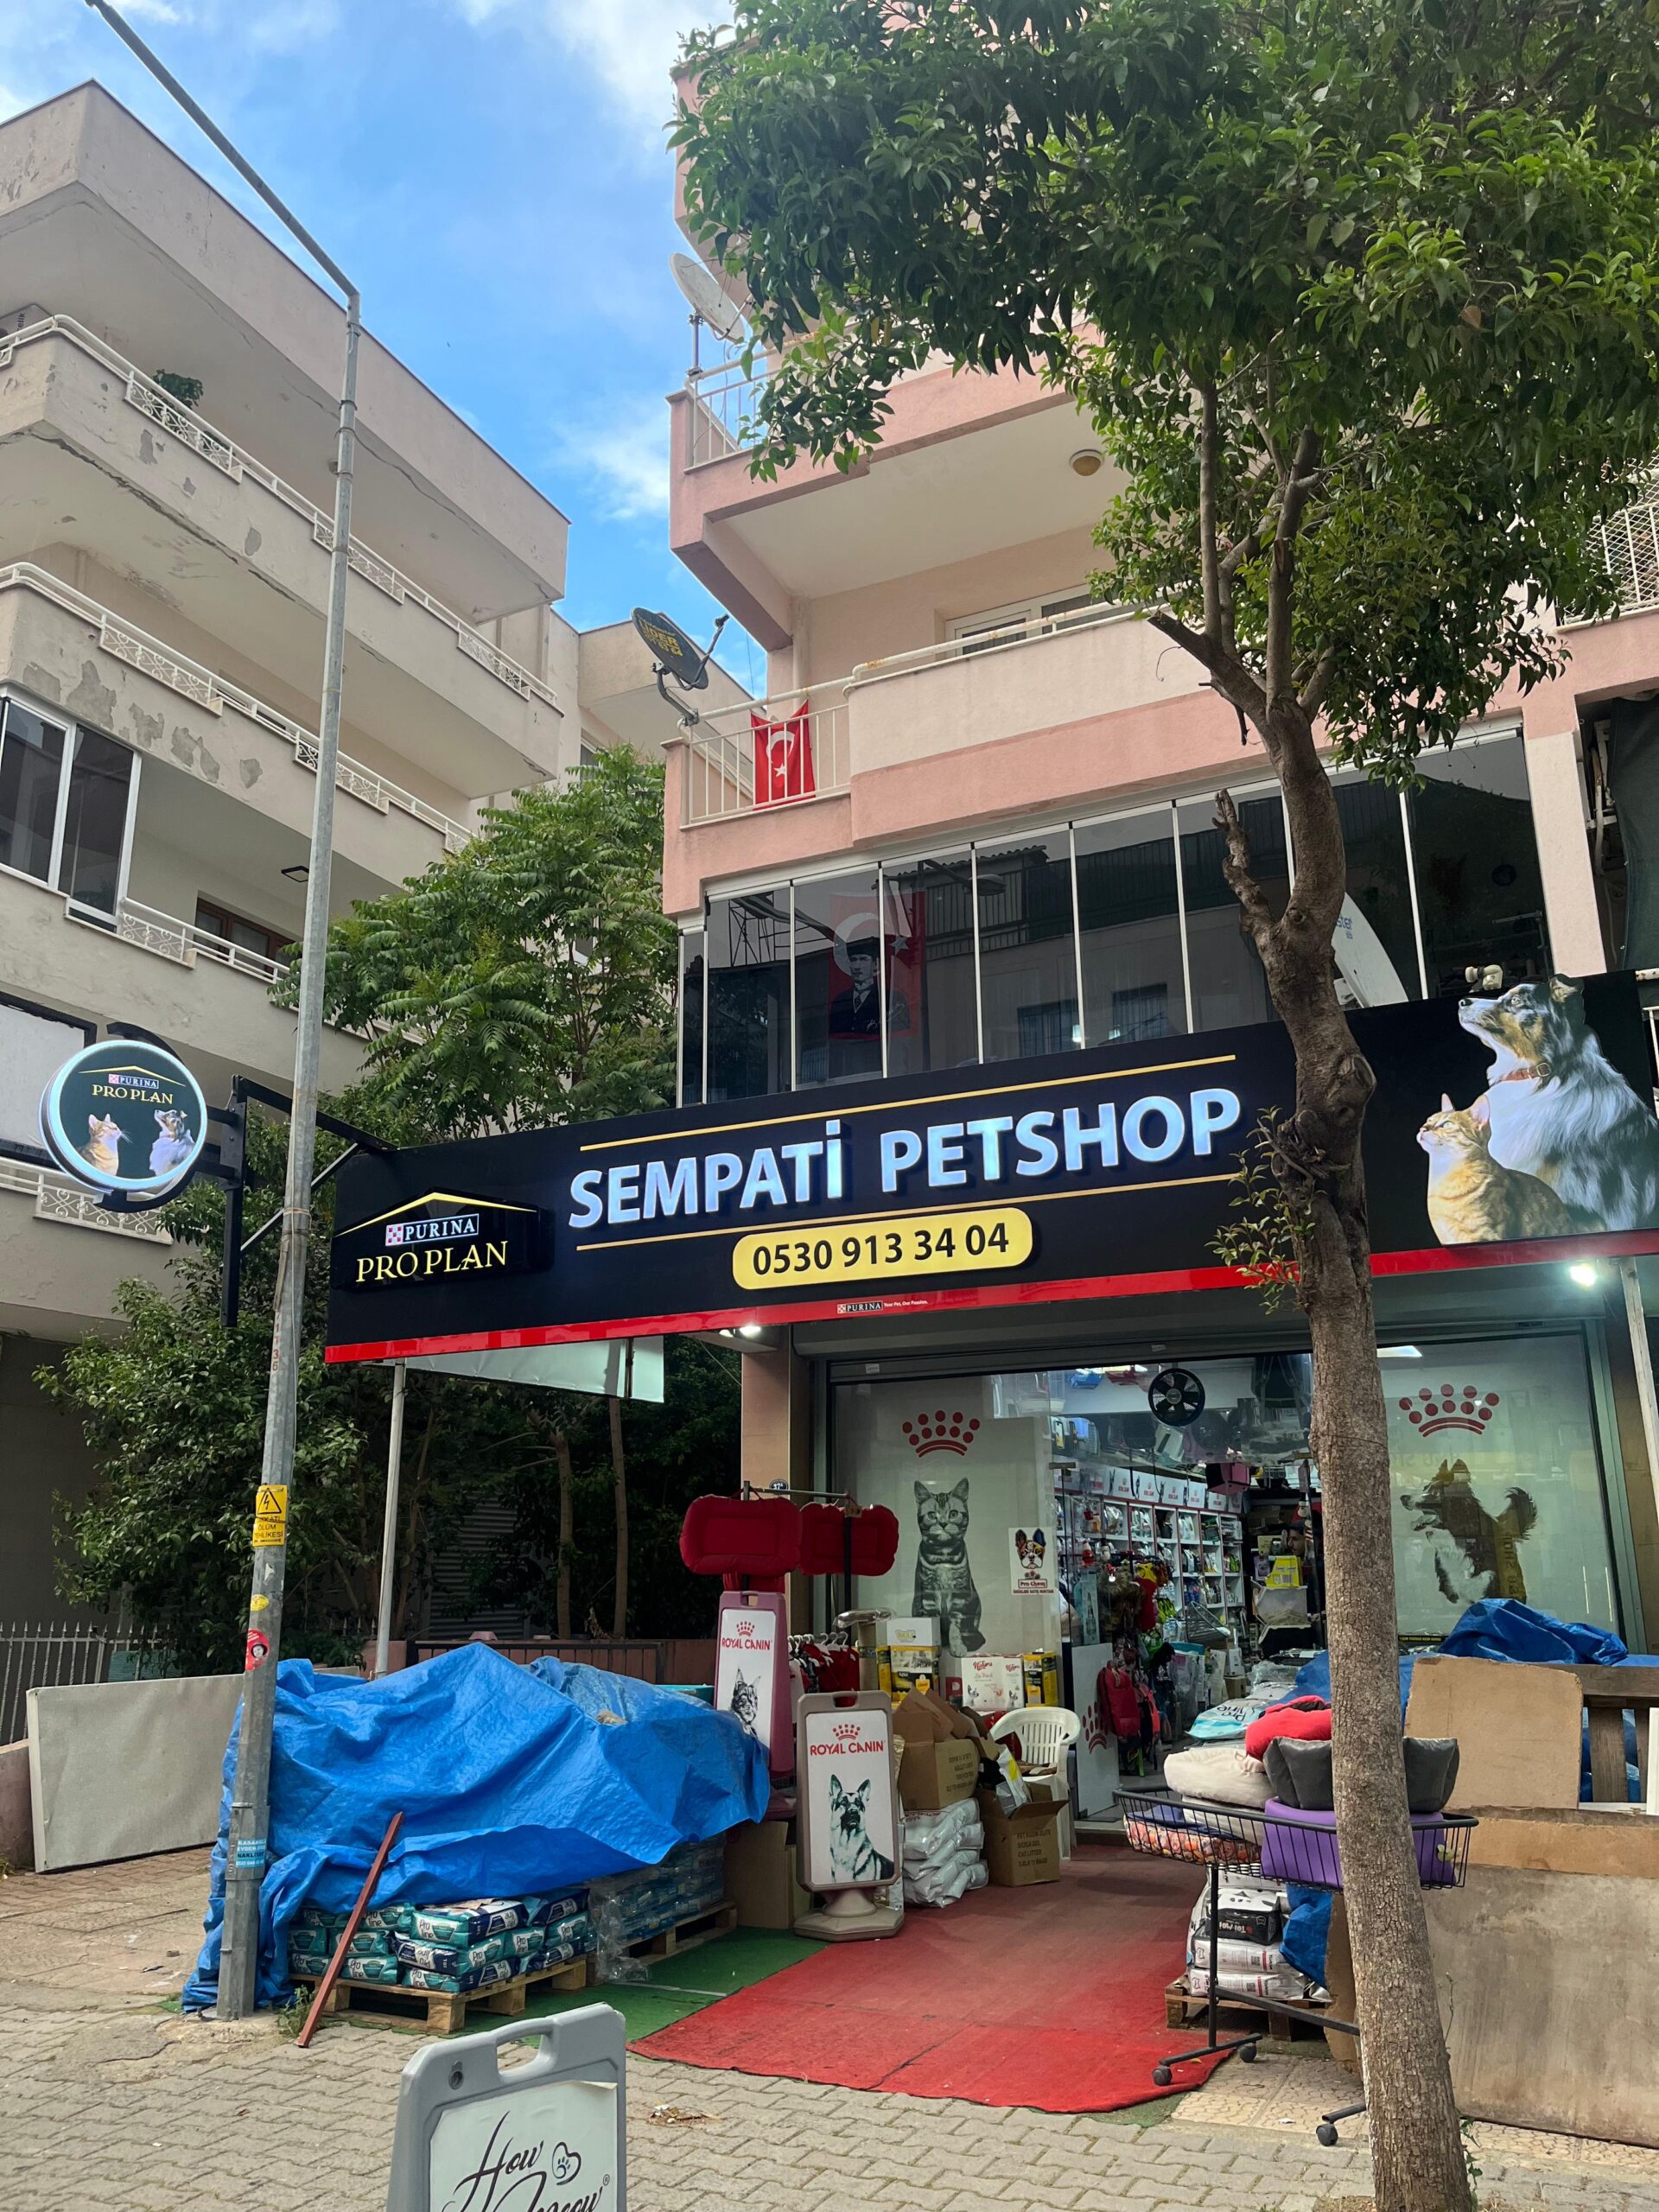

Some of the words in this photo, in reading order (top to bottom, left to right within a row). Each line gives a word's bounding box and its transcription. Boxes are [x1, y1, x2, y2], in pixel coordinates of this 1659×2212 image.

[119, 1077, 157, 1088] PURINA
[92, 1084, 128, 1098] PRO
[130, 1089, 174, 1104] PLAN
[880, 1088, 1241, 1192] PETSHOP
[404, 1217, 475, 1241] PURINA
[753, 1239, 833, 1274] 0530
[842, 1232, 903, 1268] 913
[914, 1227, 956, 1261] 34
[965, 1222, 1009, 1255] 04
[355, 1252, 419, 1282] PRO
[423, 1240, 508, 1274] PLAN
[847, 1302, 881, 1312] PURINA
[721, 1637, 743, 1649] ROYAL
[745, 1638, 771, 1650] CANIN
[810, 1743, 846, 1756] ROYAL
[848, 1739, 884, 1754] CANIN
[419, 1919, 430, 1930] Pro
[421, 1929, 434, 1938] line
